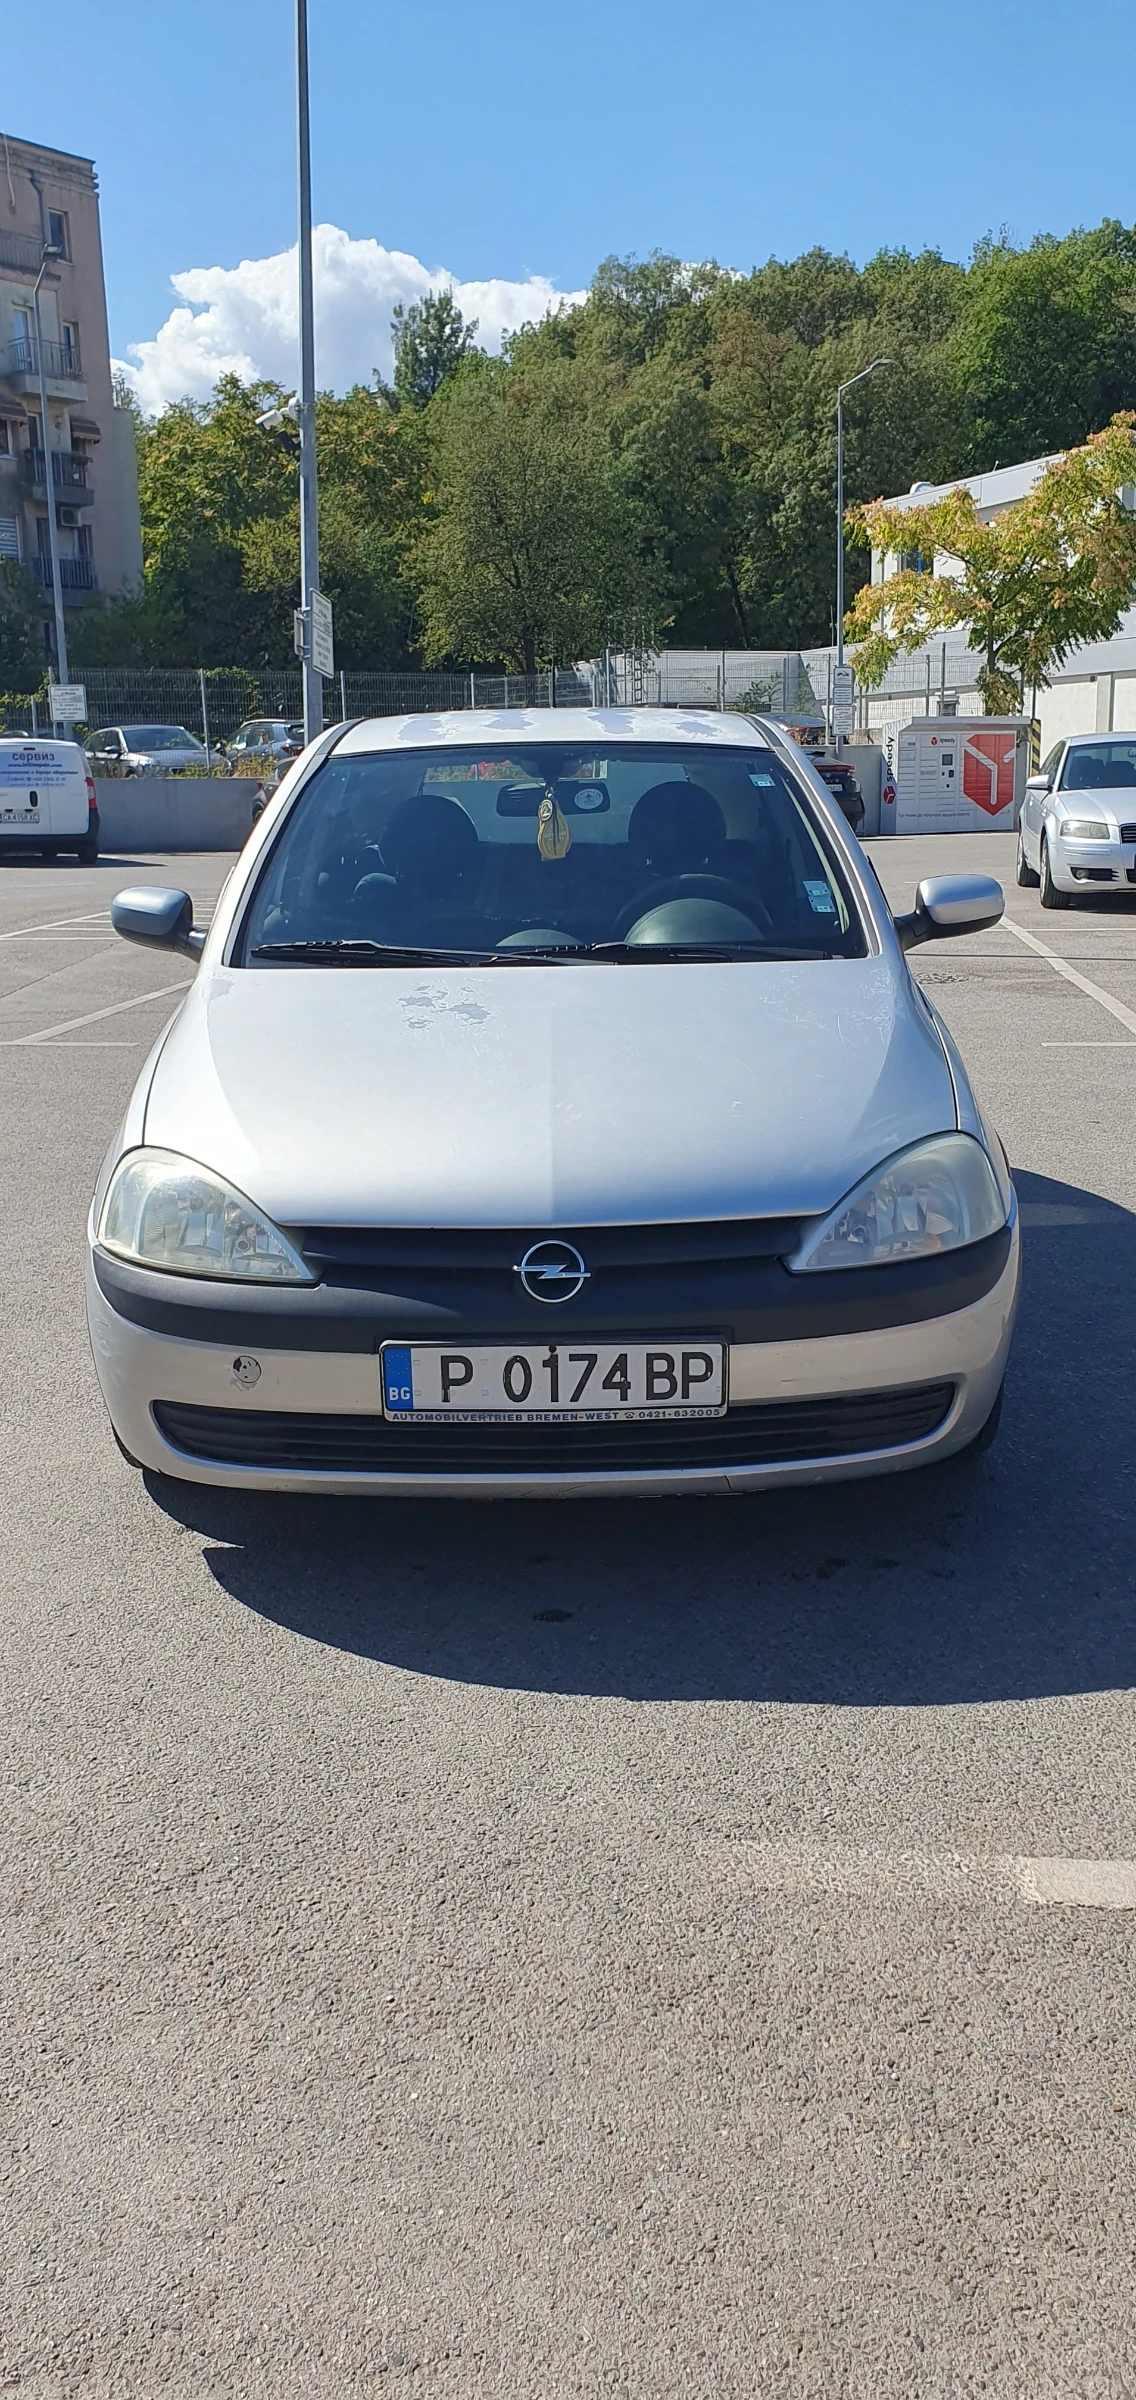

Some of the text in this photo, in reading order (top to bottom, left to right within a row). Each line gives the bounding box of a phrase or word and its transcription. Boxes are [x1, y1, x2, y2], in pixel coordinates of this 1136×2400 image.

[12, 753, 55, 762] сервиз
[886, 736, 895, 782] speedy
[441, 1355, 473, 1403] P
[389, 1387, 410, 1400] BG
[392, 1408, 720, 1421] AUTOMOBILVERTRIEB BREMEN-WEST 0421-632005
